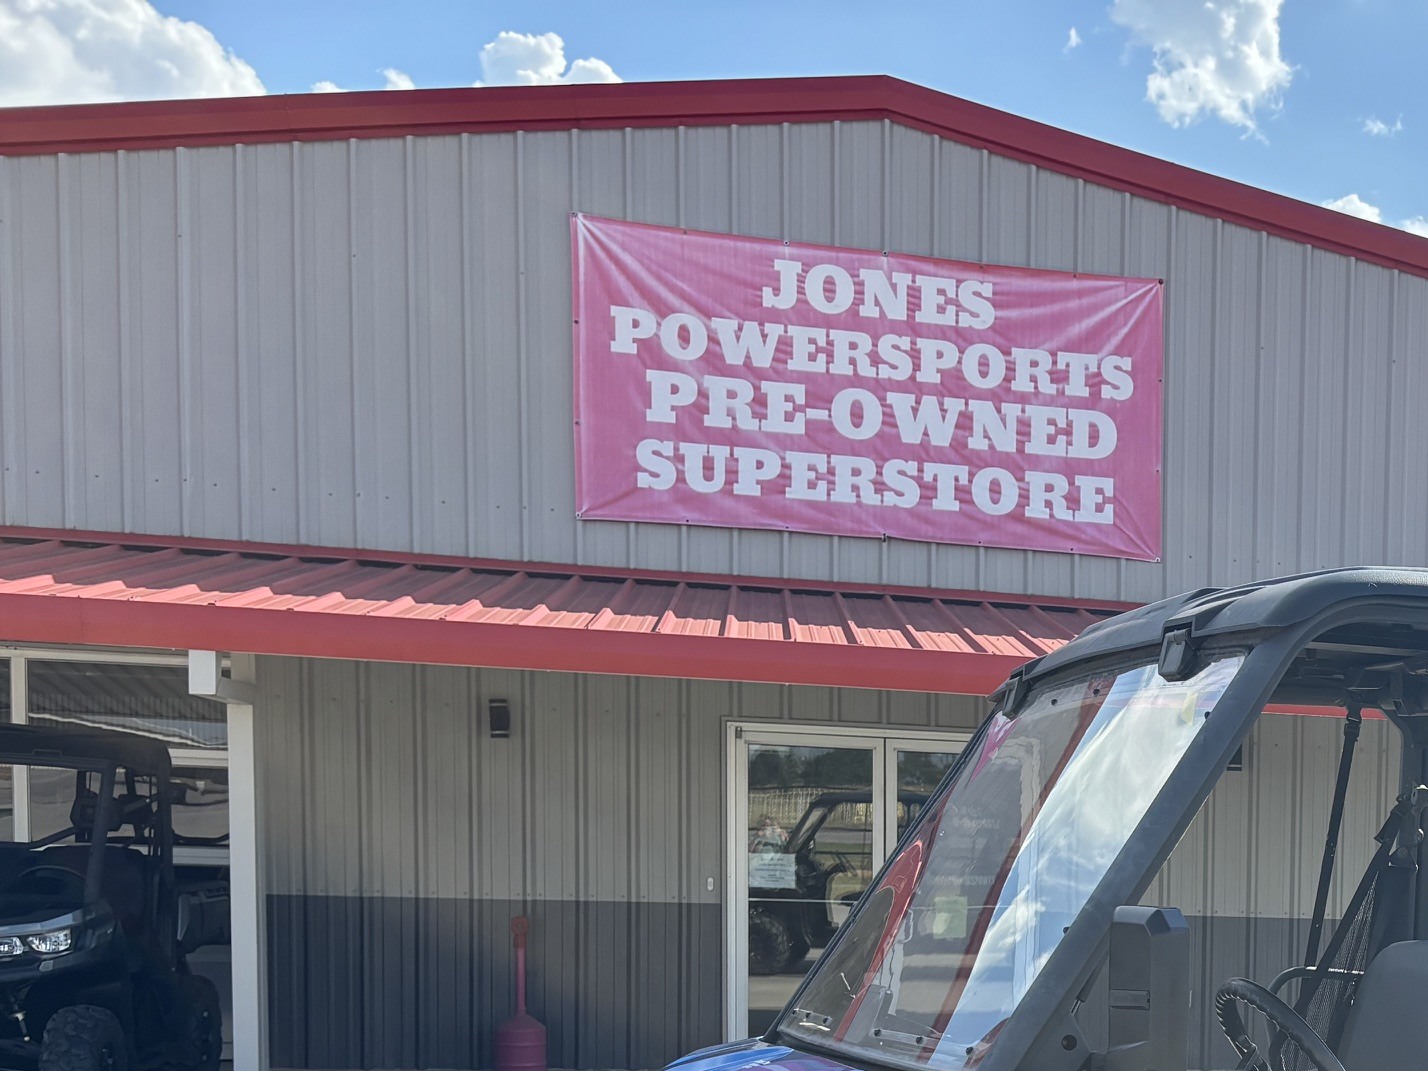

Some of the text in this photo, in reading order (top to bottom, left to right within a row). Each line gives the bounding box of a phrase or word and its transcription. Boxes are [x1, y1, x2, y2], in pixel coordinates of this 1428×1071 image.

[763, 259, 994, 330] JONES
[610, 305, 1134, 400] POWERSPORTS
[645, 370, 1117, 459] PRE-OWNED
[636, 439, 1114, 525] SUPERSTORE
